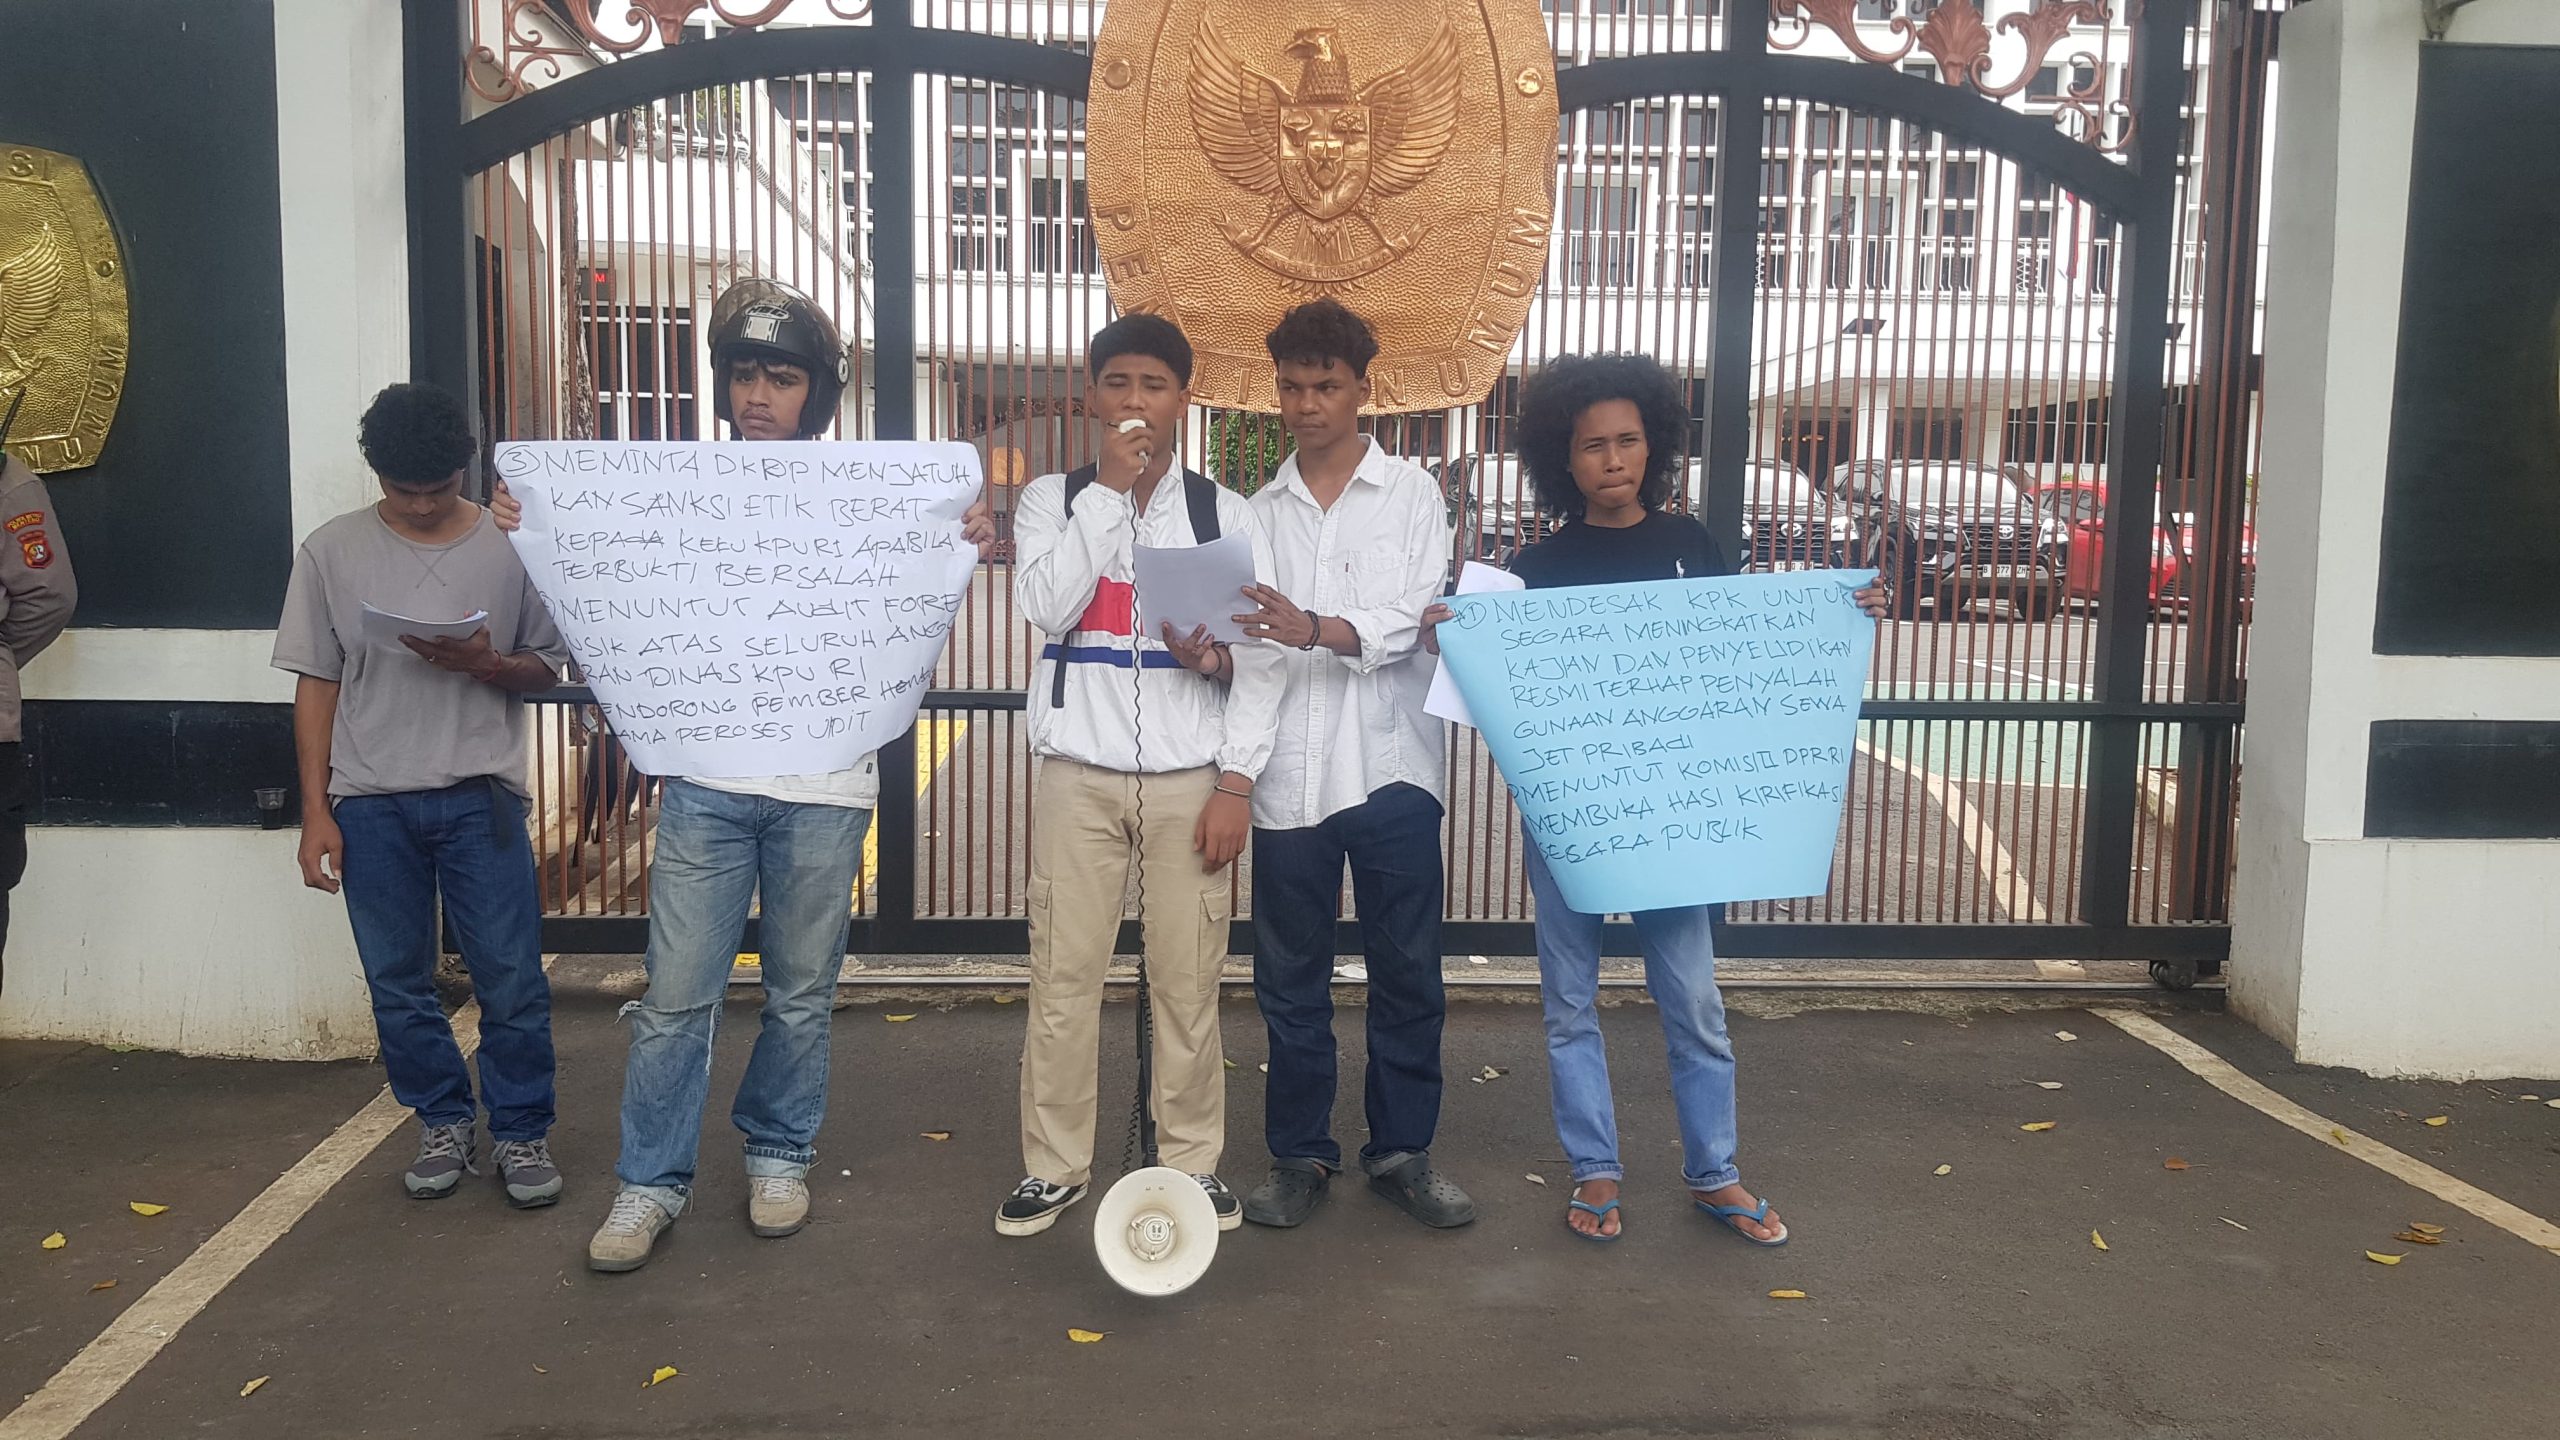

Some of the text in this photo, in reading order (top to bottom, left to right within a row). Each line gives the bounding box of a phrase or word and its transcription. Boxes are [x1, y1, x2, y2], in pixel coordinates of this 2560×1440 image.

[1438, 208, 1550, 397] UMUM
[57, 344, 127, 464] UMUM
[545, 449, 700, 480] MEMINTA
[620, 491, 731, 520] SANKSI
[743, 493, 815, 520] ETIK
[829, 496, 933, 527] BERAT
[851, 530, 955, 567] APABILA
[552, 557, 900, 588] TERBUKTI BERSALAH
[560, 597, 752, 627] MENUNTUT
[1492, 590, 1663, 625] MENDESAK
[1686, 586, 1748, 611] KPK
[1763, 586, 1854, 609] UNTUK
[638, 633, 723, 656] ATAS
[744, 630, 877, 657] SELURUH
[1500, 623, 1615, 651] SEGARA
[637, 661, 742, 688] DINAS
[751, 662, 815, 693] KPU
[829, 656, 867, 683] RI
[1612, 650, 1671, 676] DAN
[1509, 667, 1838, 709] RESMI TERHAP PENYALAH
[600, 698, 737, 719] ENDORONG
[1513, 693, 1848, 739] GUNAAN ANGGARAN SEWA
[1518, 747, 1576, 775] JET
[1520, 761, 1664, 805] MENUNTUT
[1526, 796, 1656, 836] MEMBUKA
[1668, 787, 1724, 814] HASI
[1660, 817, 1764, 851] PUBLIK
